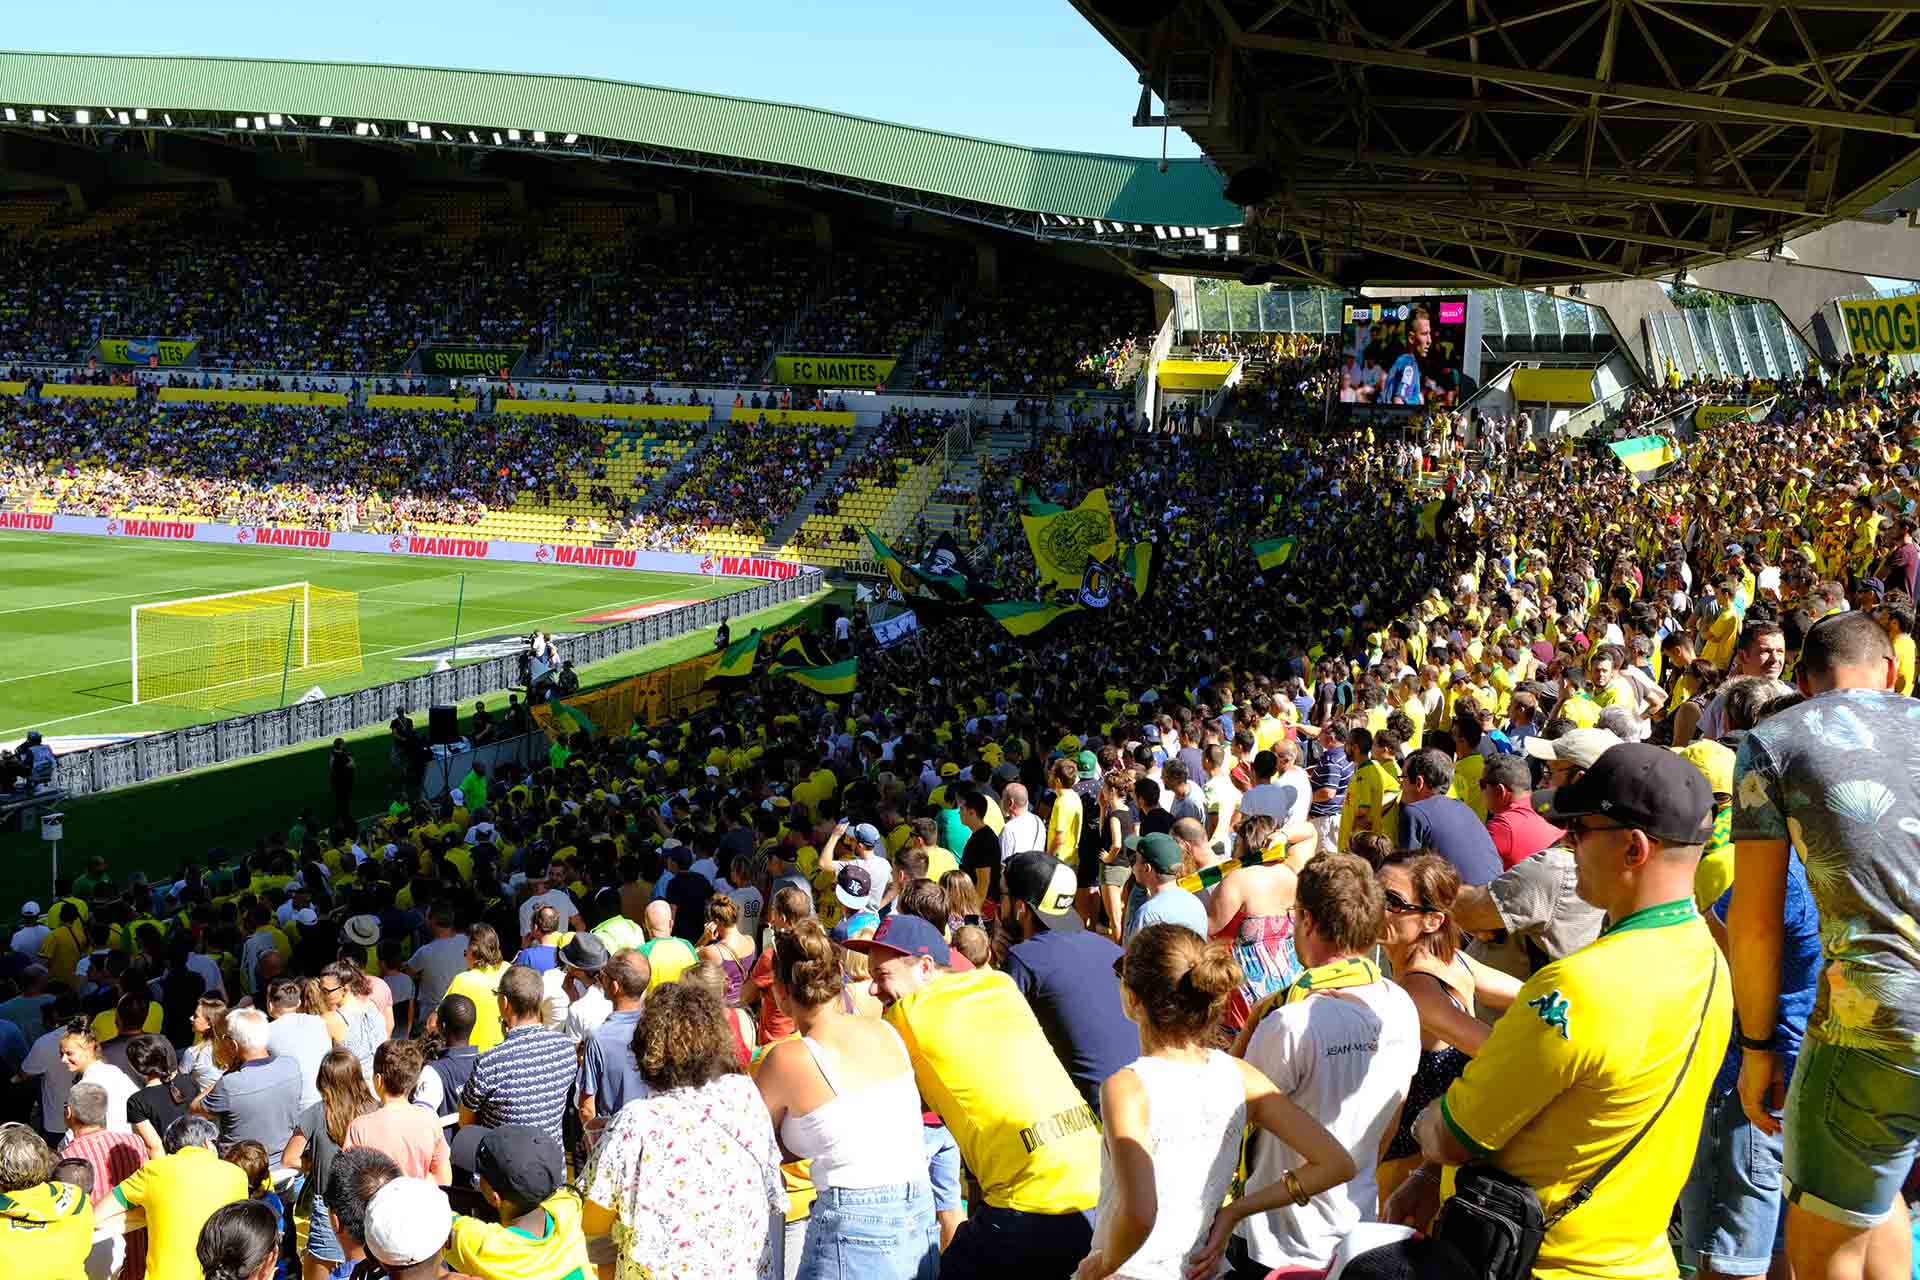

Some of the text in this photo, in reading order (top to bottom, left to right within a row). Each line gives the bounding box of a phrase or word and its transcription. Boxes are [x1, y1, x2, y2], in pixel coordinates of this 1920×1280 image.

[1845, 302, 1920, 351] PROG
[434, 352, 509, 369] SYNERGIE
[793, 362, 876, 382] FC NANTES
[0, 512, 53, 529] ANITOU
[124, 520, 195, 539] MANITOU
[255, 527, 330, 548] MANITOU
[408, 536, 489, 558] MANITOU
[555, 545, 636, 568] MANITOU
[721, 556, 797, 580] MANITOU
[1019, 1103, 1098, 1153] DOTMUN
